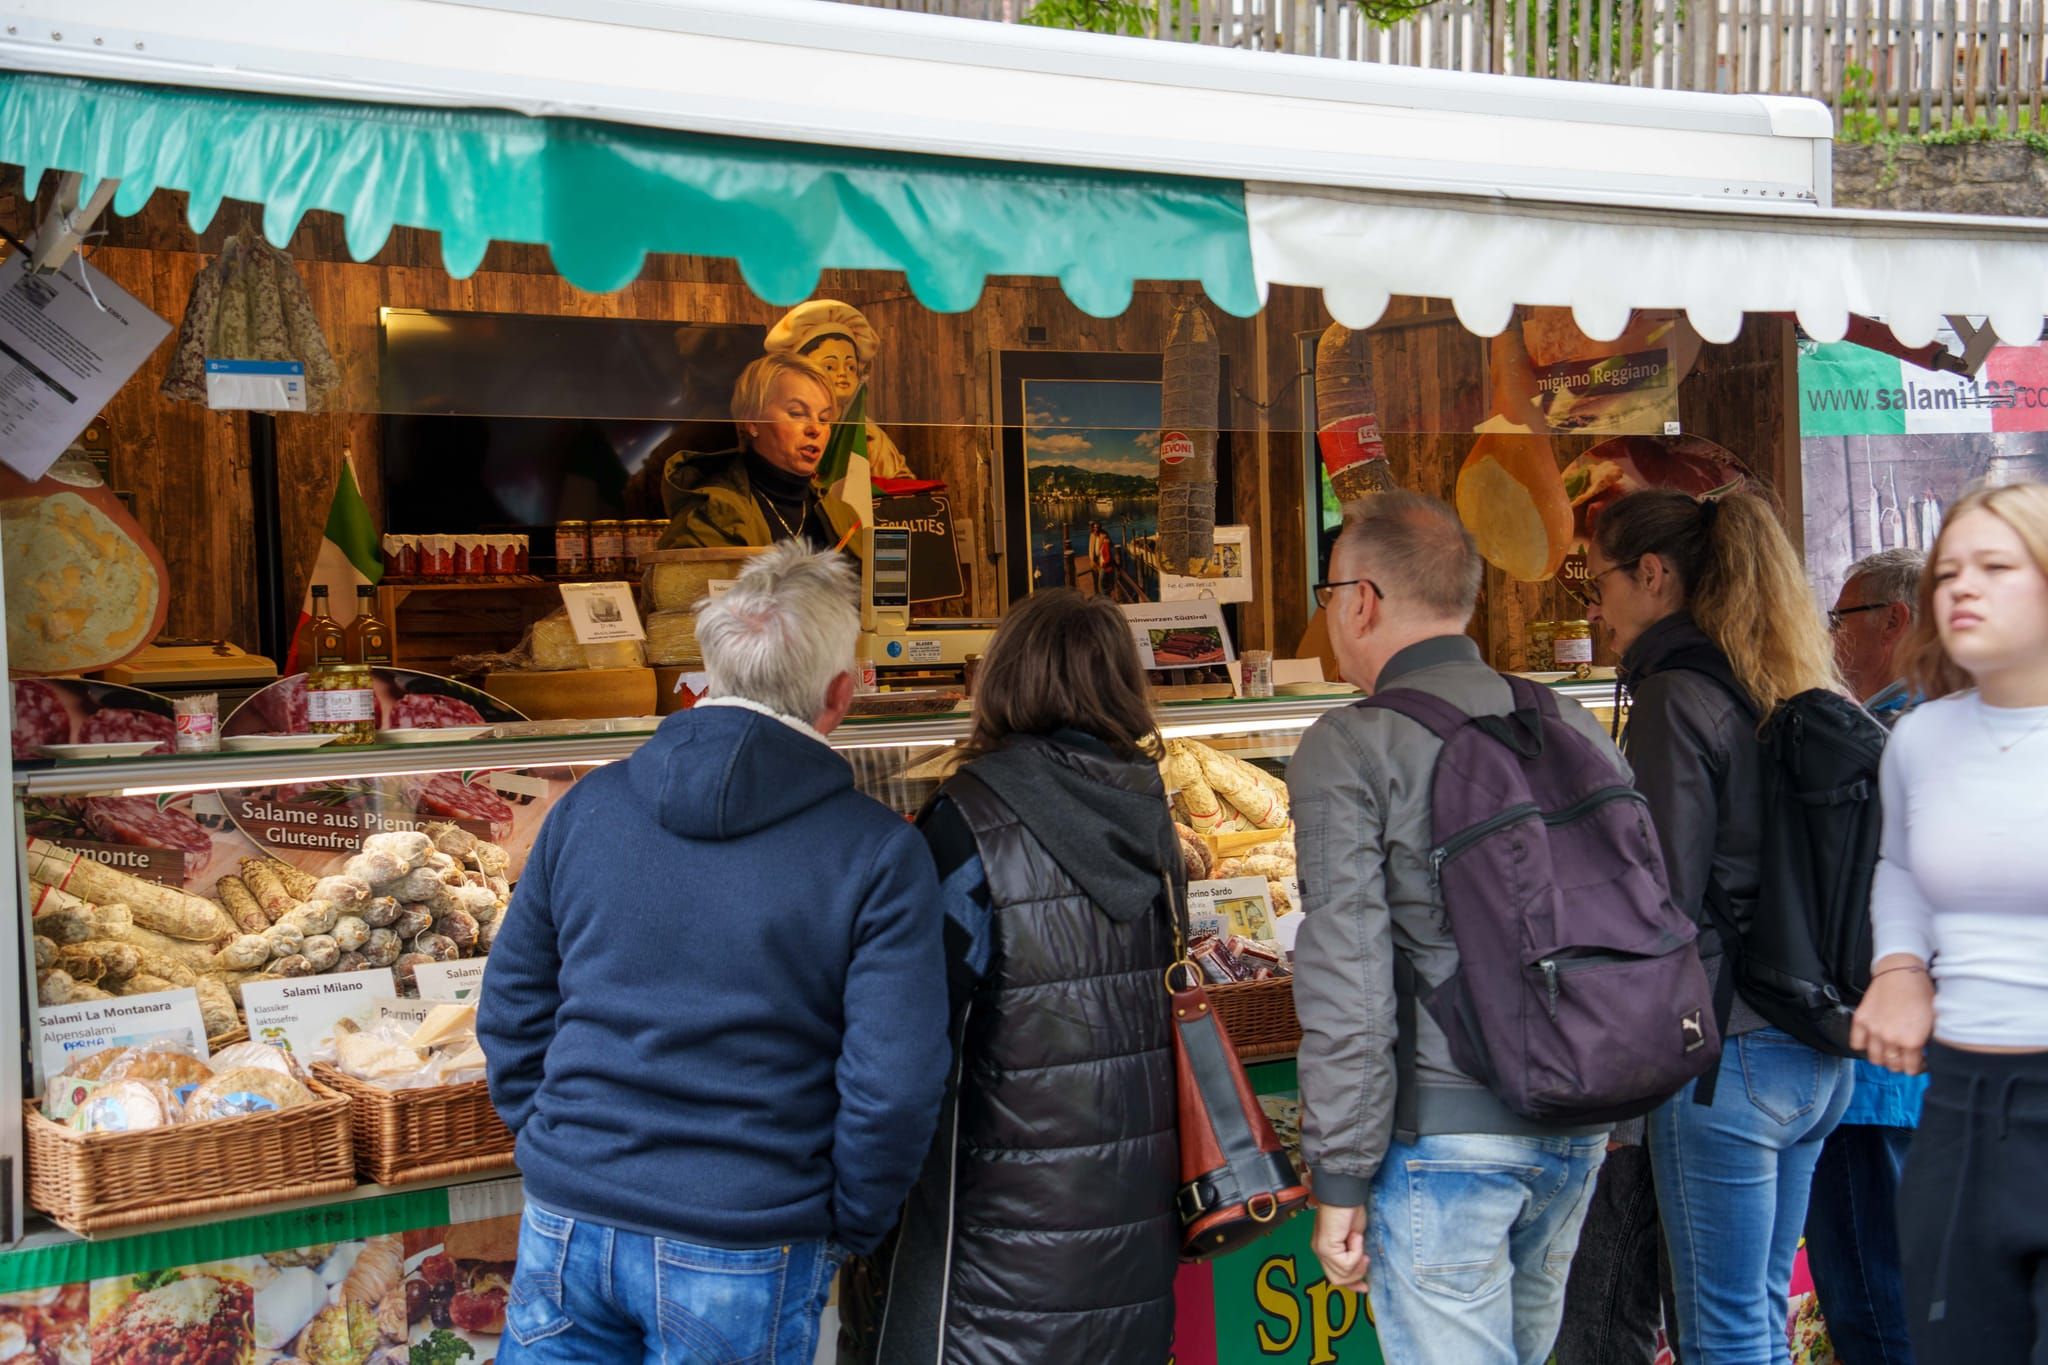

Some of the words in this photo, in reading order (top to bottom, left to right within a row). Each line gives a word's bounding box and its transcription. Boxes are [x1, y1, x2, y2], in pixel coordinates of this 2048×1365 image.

[1594, 363, 1660, 386] Reggiano
[1162, 443, 1192, 455] LEVONI
[242, 801, 318, 825] Salame
[323, 812, 359, 829] aus
[265, 827, 360, 850] Glutenfrei
[1210, 887, 1233, 896] Sardo
[446, 966, 482, 979] Salami
[282, 984, 321, 998] Salami
[323, 980, 364, 994] Milano
[39, 1011, 83, 1027] Salami
[86, 1009, 101, 1022] La
[103, 1001, 172, 1019] Montanara
[253, 1003, 289, 1014] Klassiker
[43, 1024, 118, 1043] Alpensalami
[1254, 1254, 1376, 1365] Sp
